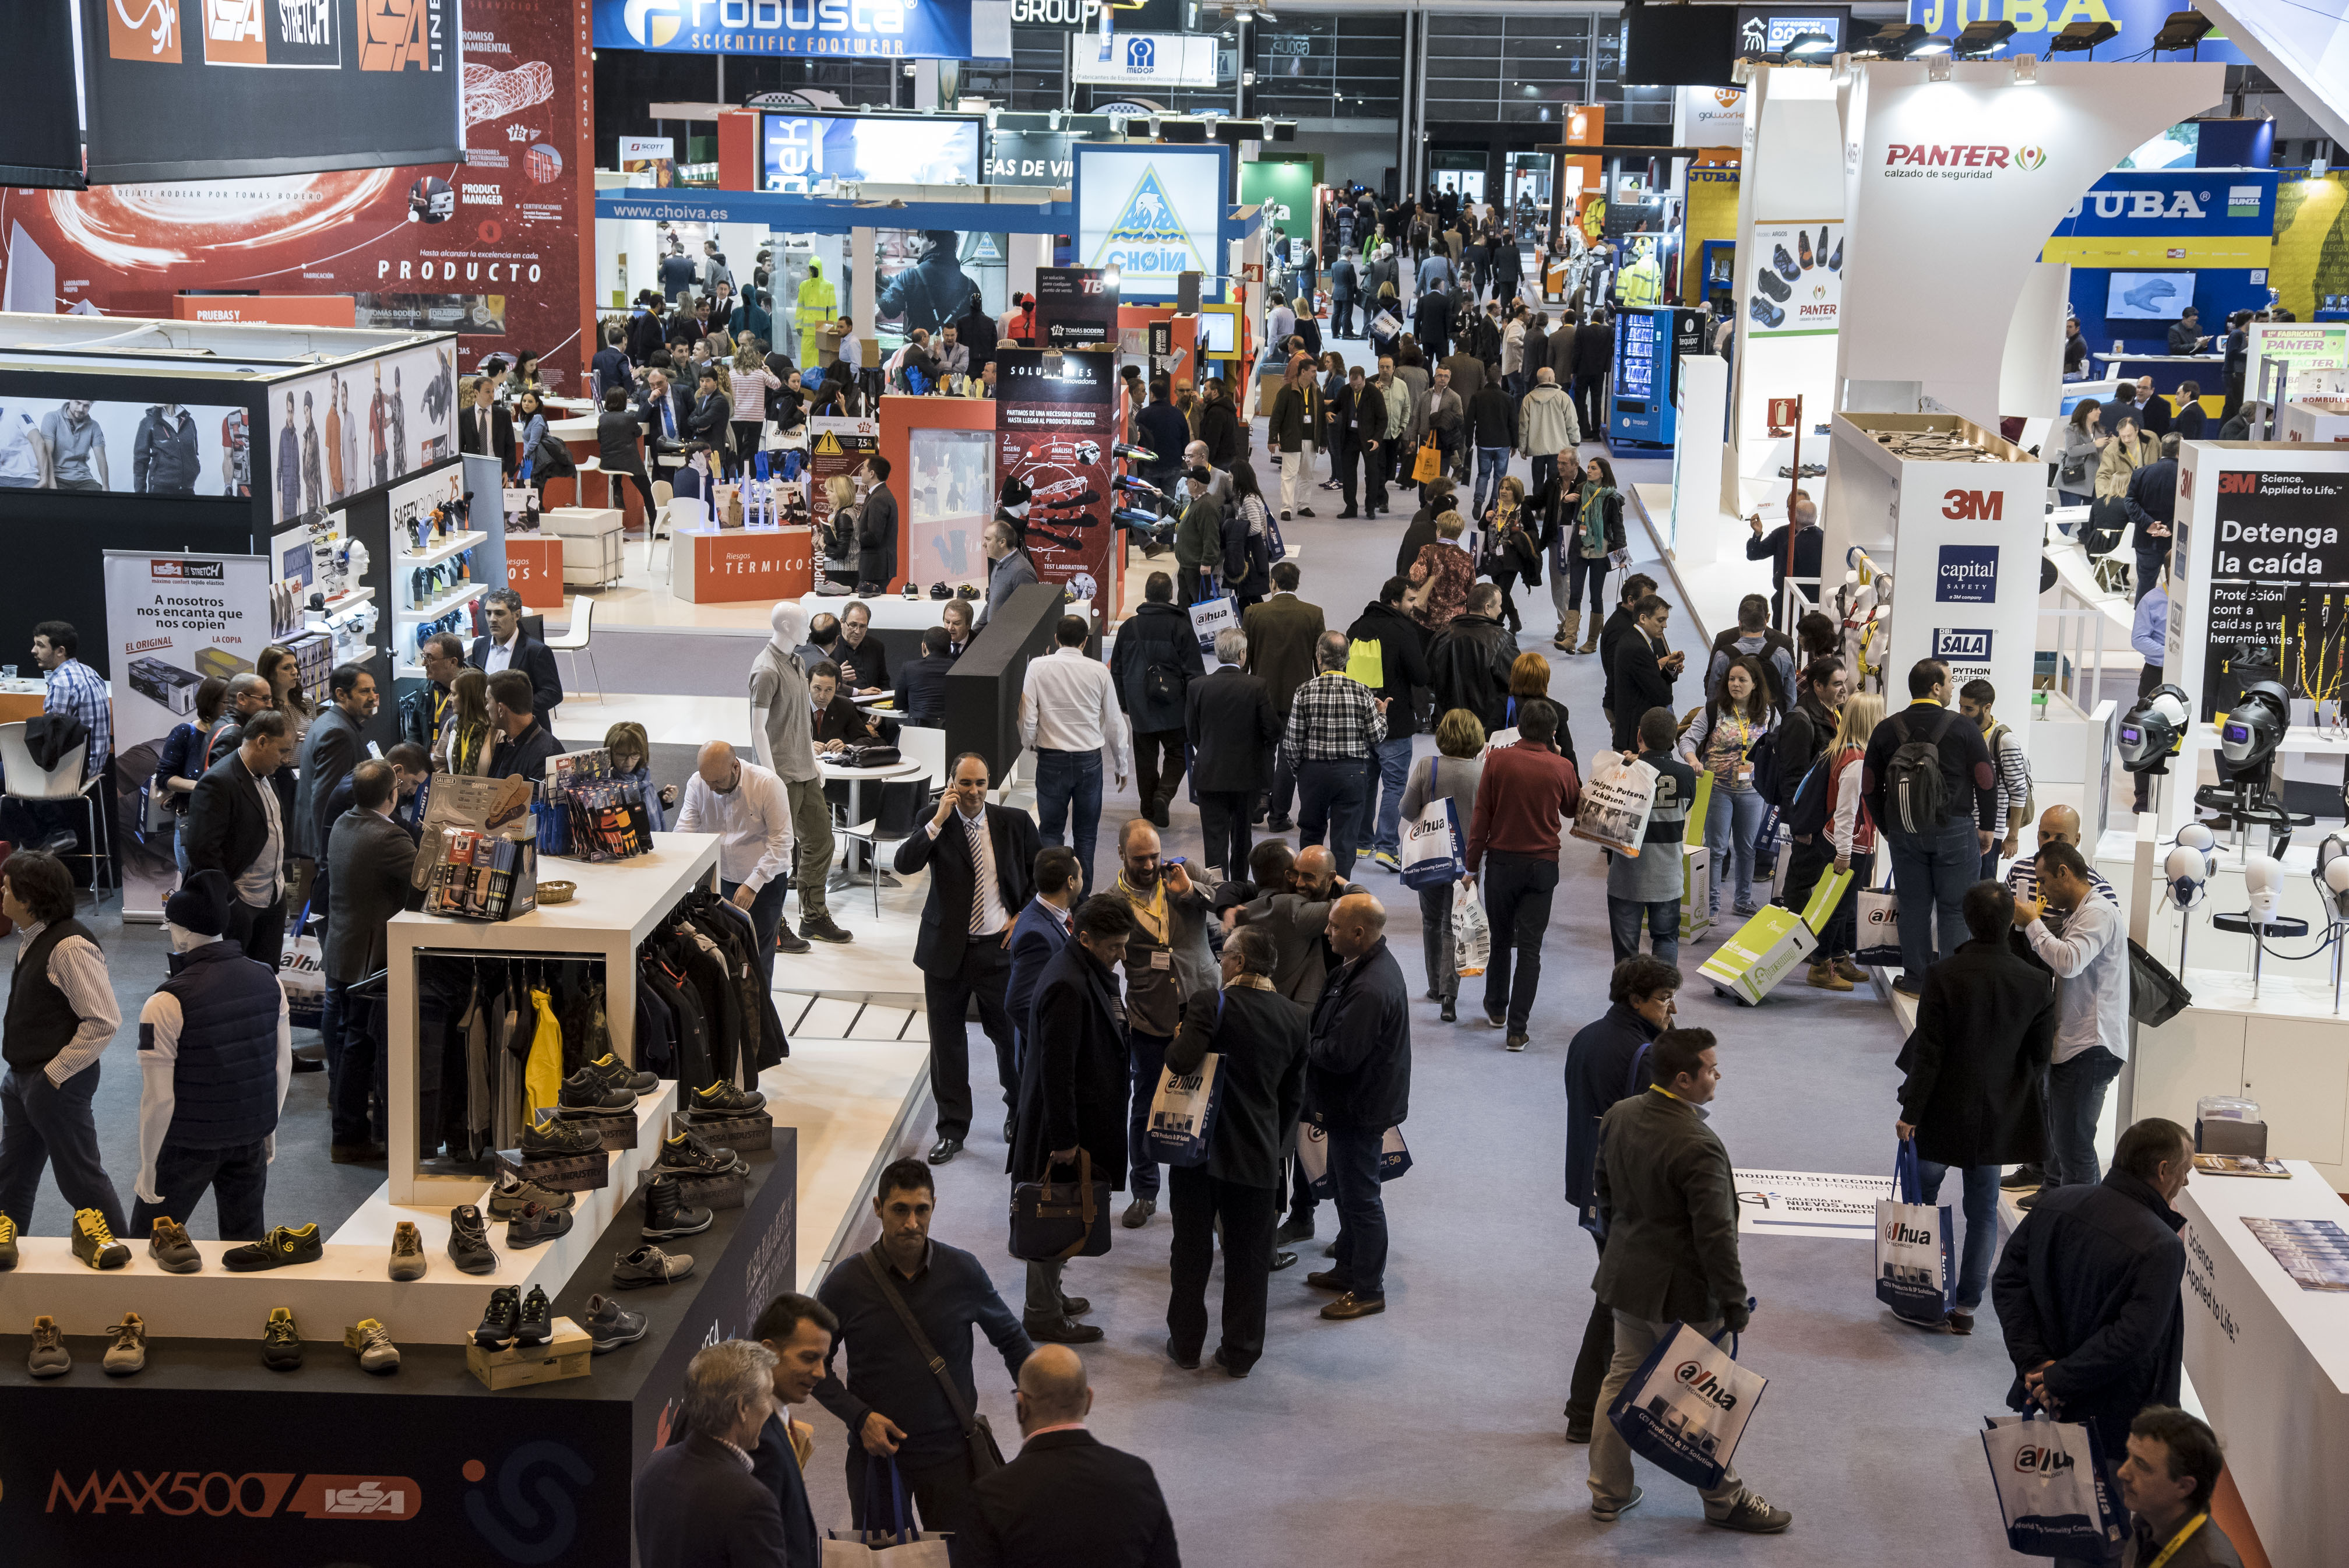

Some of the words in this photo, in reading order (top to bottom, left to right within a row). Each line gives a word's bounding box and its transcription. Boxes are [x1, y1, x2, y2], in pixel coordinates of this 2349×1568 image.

[1012, 0, 1098, 23] GROUP
[1923, 0, 2122, 34] JUBA
[692, 33, 796, 51] SCIENTIFIC
[807, 37, 903, 54] FOOTWEAR
[1886, 145, 2009, 169] PANTER
[1022, 160, 1044, 177] DE
[1885, 169, 1923, 178] calzado
[1926, 169, 1939, 178] de
[1941, 170, 1992, 180] seguridad
[1689, 171, 1741, 182] JUBA
[160, 190, 202, 198] RODEAR
[235, 190, 271, 199] TOMÁS
[278, 192, 322, 201] BODERO
[462, 184, 500, 193] PRODUCT
[462, 195, 503, 205] MANAGER
[2065, 191, 2206, 218] JUBA
[614, 204, 728, 218] www.choiva.es
[378, 260, 541, 283] PRODUCTO
[1083, 280, 1104, 293] TB
[197, 310, 233, 320] PRUEBAS
[234, 310, 240, 320] Y
[369, 308, 392, 317] TOMÁS
[1800, 304, 1837, 315] PANTER
[1679, 337, 1698, 346] tequipo
[2266, 340, 2325, 350] PANTER
[1003, 434, 1011, 445] 2.
[2218, 473, 2256, 494] 3M
[2262, 474, 2304, 483] Science.
[2260, 485, 2300, 495] Applied
[1942, 489, 2003, 520] 3M
[2221, 520, 2338, 549] Detenga
[1045, 552, 1052, 562] 4.
[2218, 551, 2240, 572] la
[2248, 552, 2322, 574] caída
[191, 563, 221, 577] STRETCH
[1941, 561, 1994, 581] capital
[155, 595, 163, 605] A
[167, 597, 224, 607] nosotros
[137, 607, 160, 616] nos
[163, 608, 214, 618] encanta
[219, 610, 243, 621] que
[156, 619, 178, 628] nos
[182, 619, 226, 631] copien
[126, 643, 134, 651] EL
[136, 636, 172, 650] ORIGINAL
[1941, 636, 1983, 653] SALA
[1751, 1179, 1820, 1188] SELECTED
[1826, 1183, 1891, 1192] PRODUCT
[1787, 1200, 1840, 1208] NUEVOS
[2188, 1224, 2215, 1280] Science.
[1892, 1283, 1908, 1292] Products
[1918, 1288, 1936, 1296] Solutions
[2186, 1257, 2212, 1309] Applied
[2213, 1298, 2220, 1320] to
[1685, 1384, 1717, 1410] TECHNOLOGY
[1649, 1419, 1675, 1443] Products
[1675, 1440, 1682, 1449] &
[1681, 1444, 1689, 1453] IP
[1689, 1449, 1714, 1469] Solutions
[45, 1469, 266, 1518] MAX500
[2044, 1526, 2071, 1534] Security
